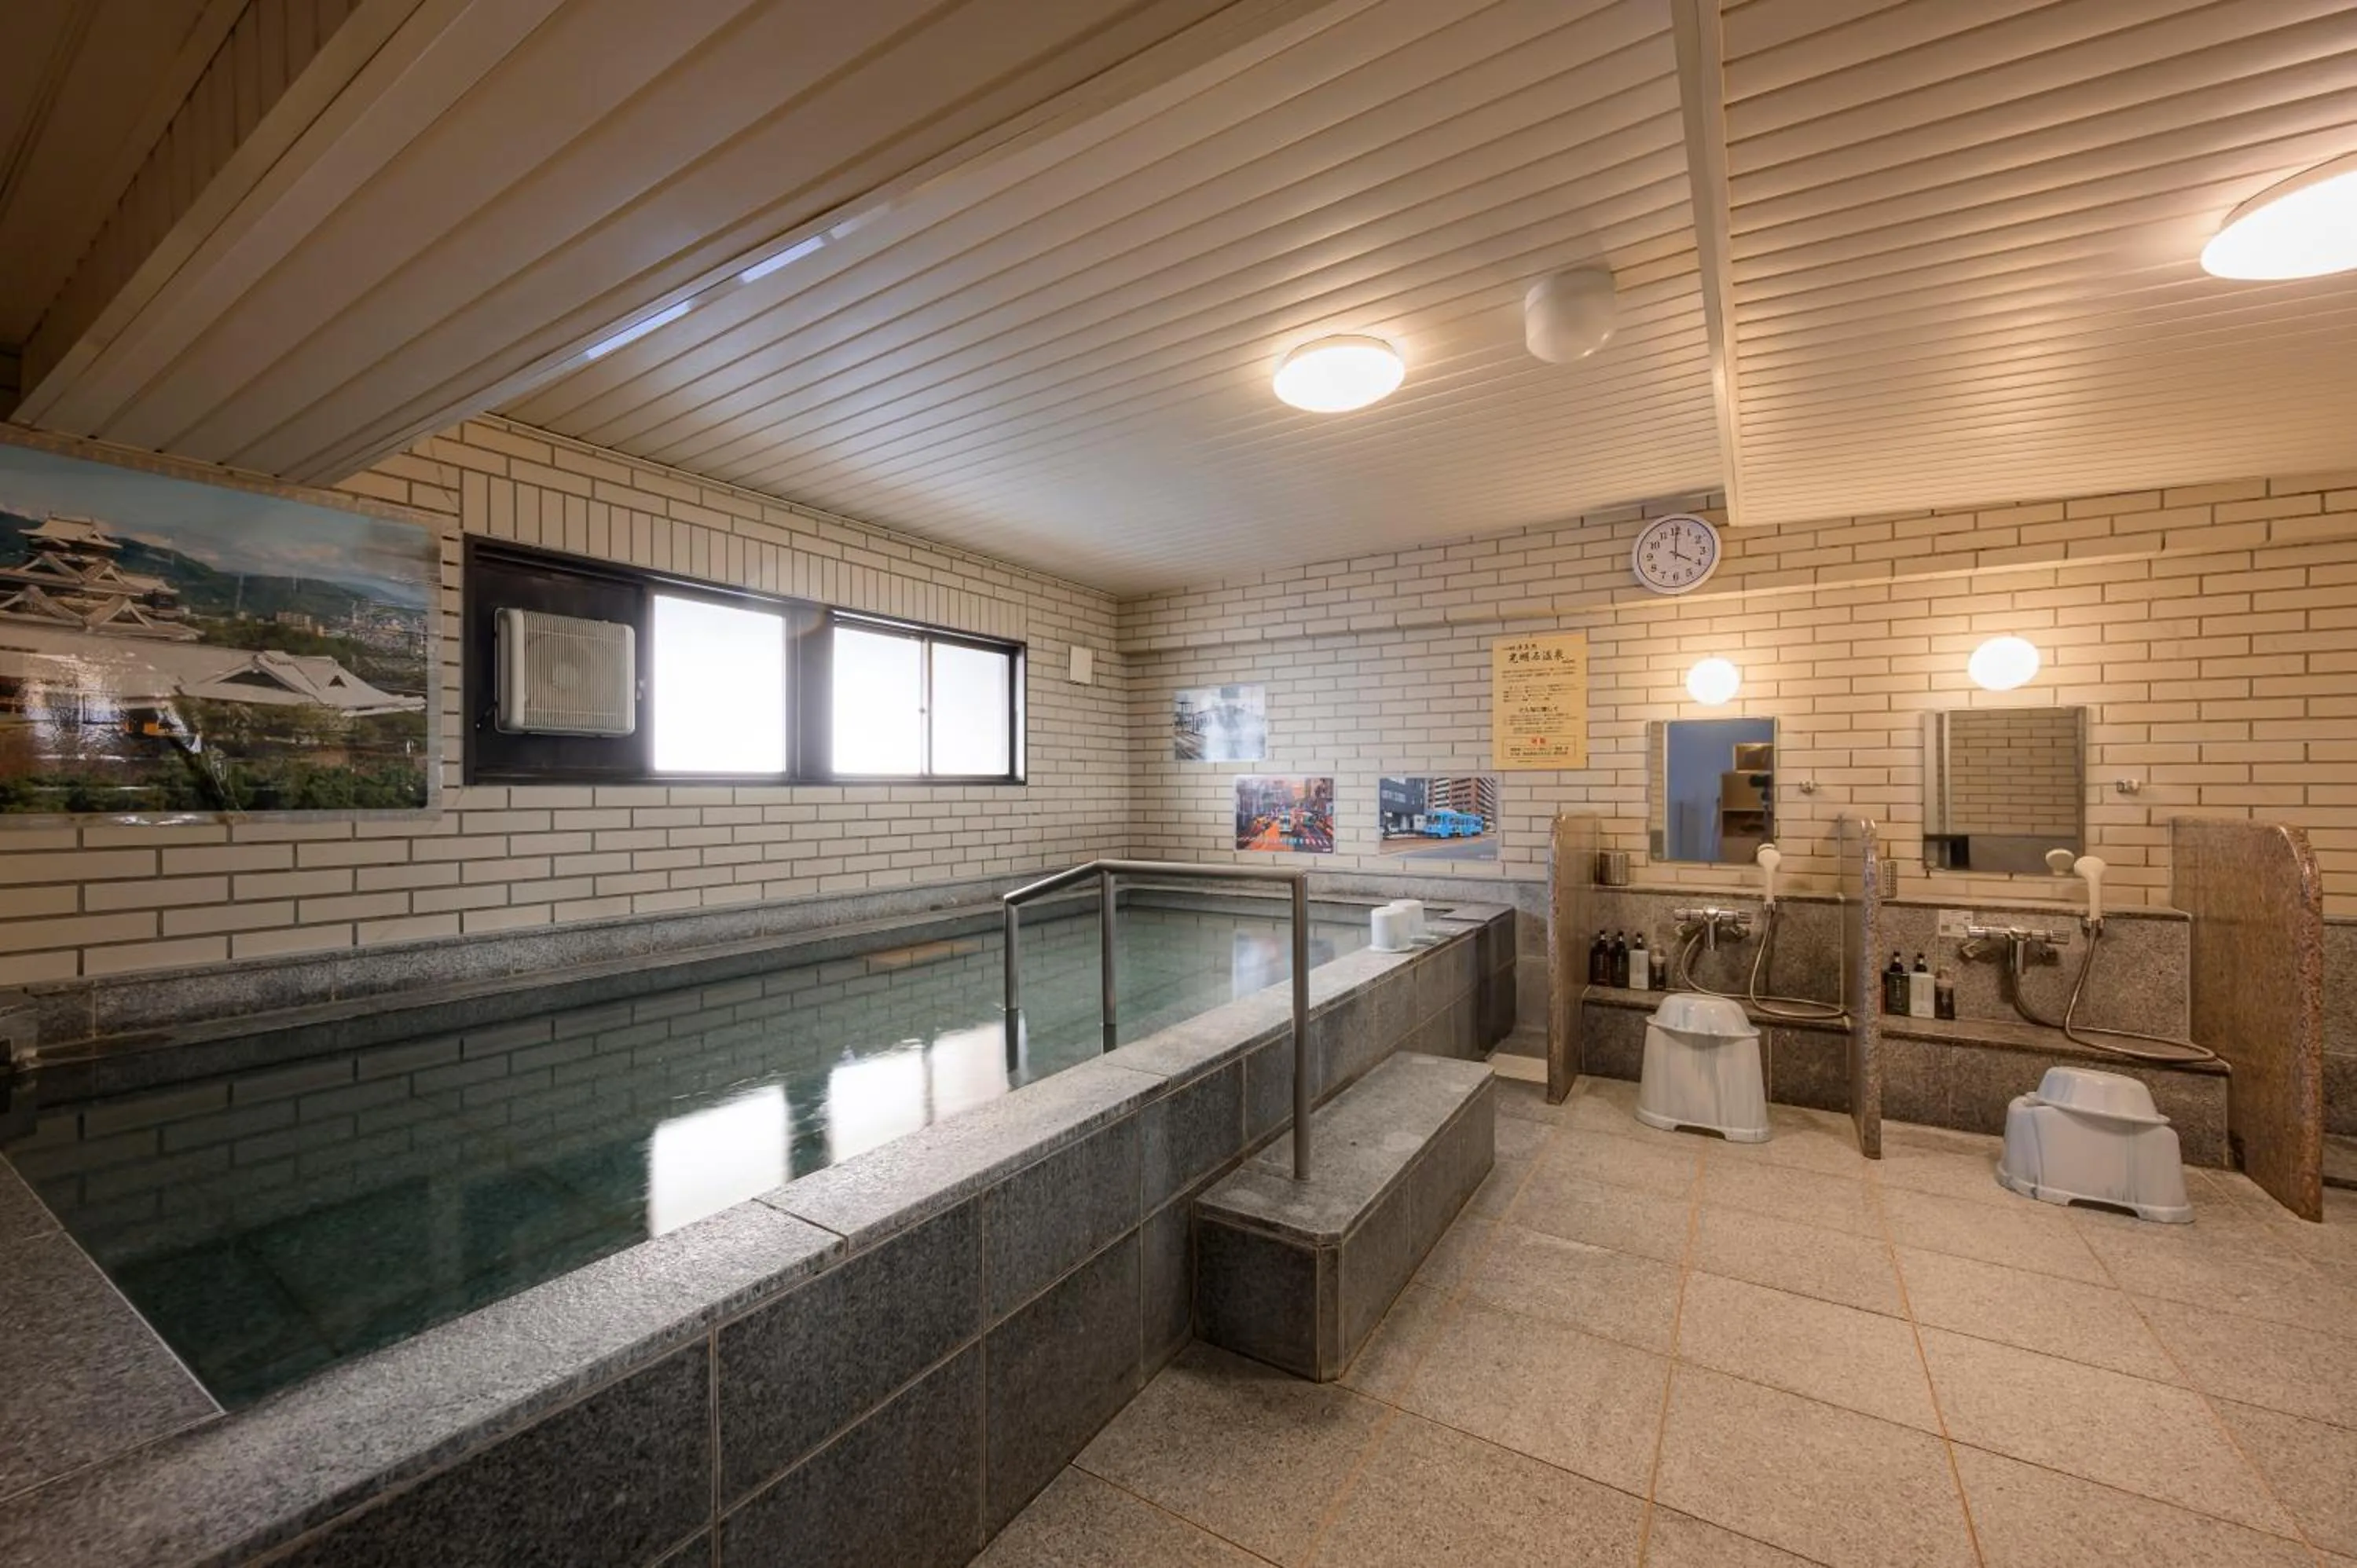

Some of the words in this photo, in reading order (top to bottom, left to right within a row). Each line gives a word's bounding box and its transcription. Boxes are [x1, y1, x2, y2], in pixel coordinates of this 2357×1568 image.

[1659, 532, 1667, 540] 11
[1695, 534, 1703, 544] 2
[1650, 540, 1660, 549] 10
[1699, 546, 1706, 555] 3
[1651, 563, 1657, 573] 8
[1685, 568, 1693, 577] 5
[1659, 570, 1666, 579] 7
[1673, 572, 1679, 581] 6
